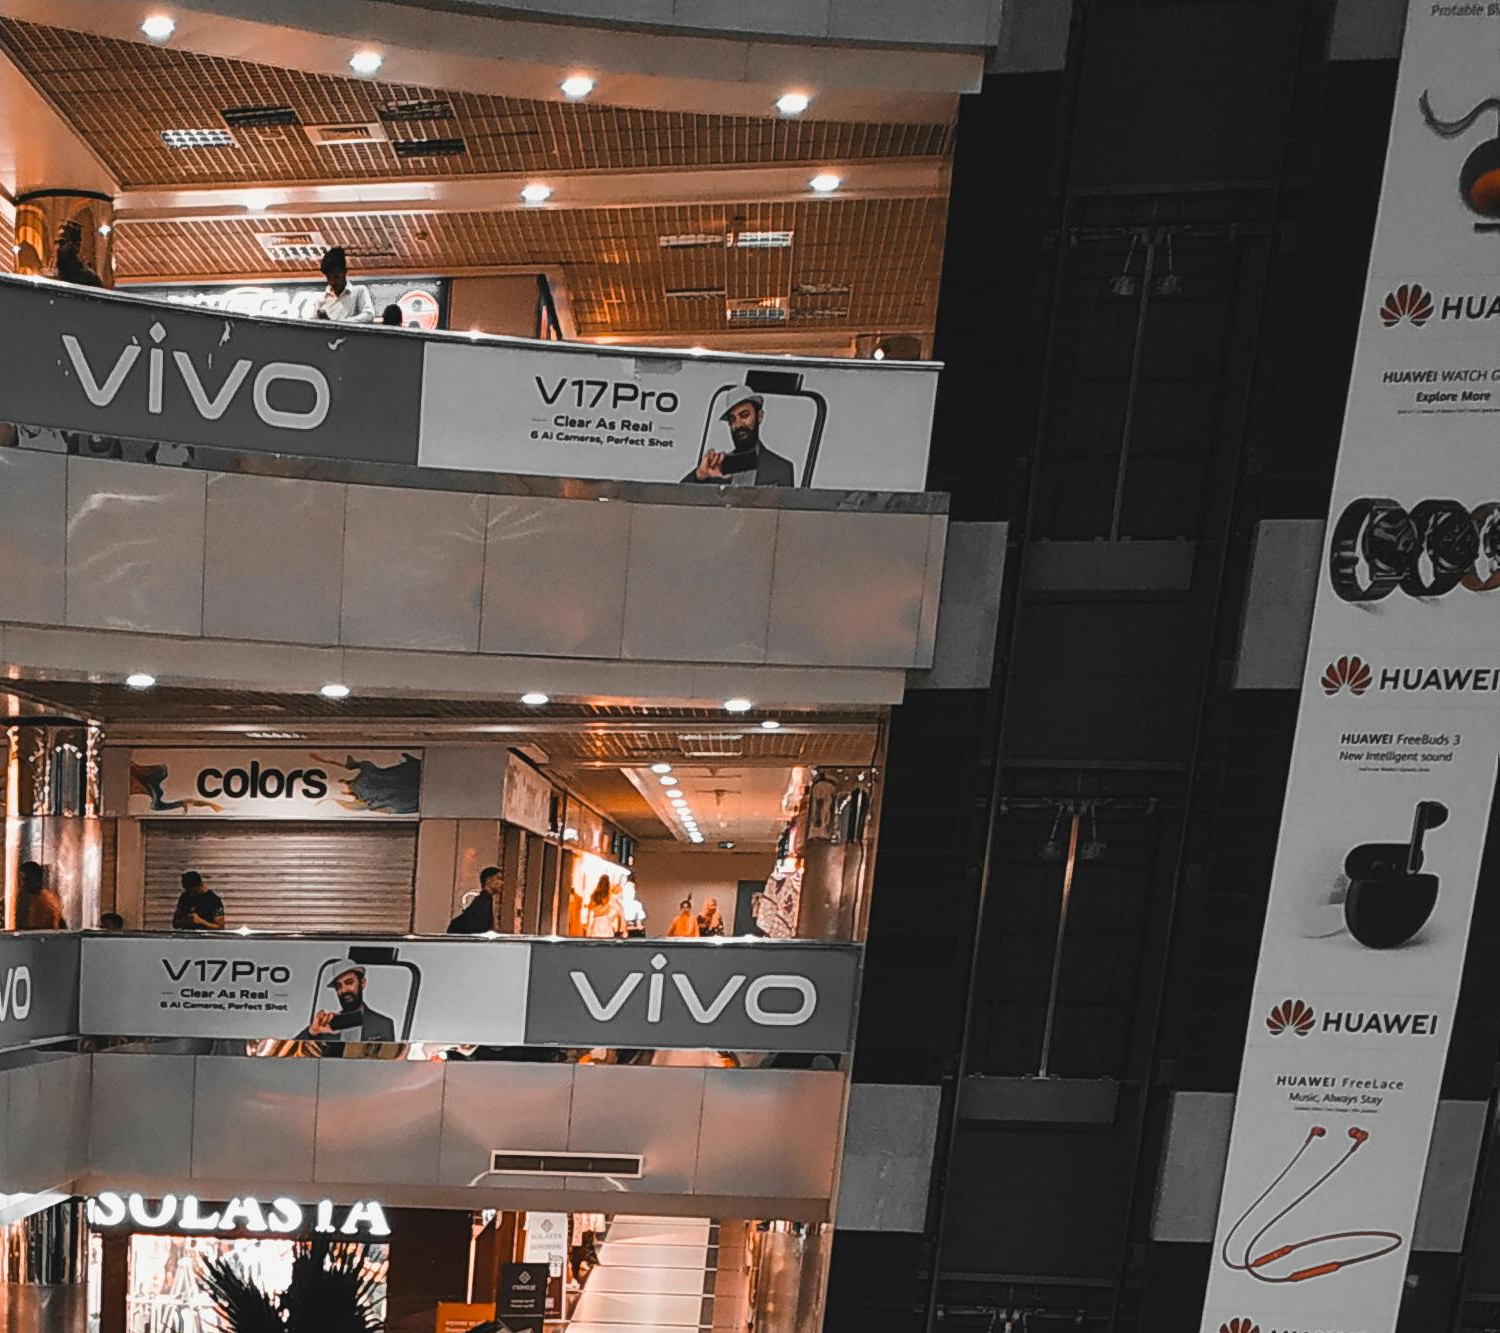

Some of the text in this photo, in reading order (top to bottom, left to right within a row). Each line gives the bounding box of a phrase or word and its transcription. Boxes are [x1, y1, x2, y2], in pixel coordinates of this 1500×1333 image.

[61, 321, 331, 431] vivo
[1382, 371, 1438, 383] HUAWEI
[1442, 370, 1488, 382] WATCH
[1415, 391, 1491, 404] Explore More
[553, 415, 653, 433] Clear As Real
[530, 430, 674, 448] 6 AI Cameras, Perfect Shot
[1379, 668, 1500, 691] HUAWEI
[1341, 733, 1461, 745] HUAWEI FreeBuds 3
[1339, 751, 1453, 763] New Intelligent sound
[197, 760, 328, 799] colors
[180, 988, 269, 1000] Clear As Real
[569, 952, 818, 1027] vivo
[183, 1002, 225, 1010] Cameras,
[265, 1003, 288, 1011] Shot
[1322, 1012, 1438, 1036] HUAWEI
[1276, 1075, 1404, 1090] HUAWEI FreeLace
[1289, 1092, 1383, 1107] Music, Always Stay
